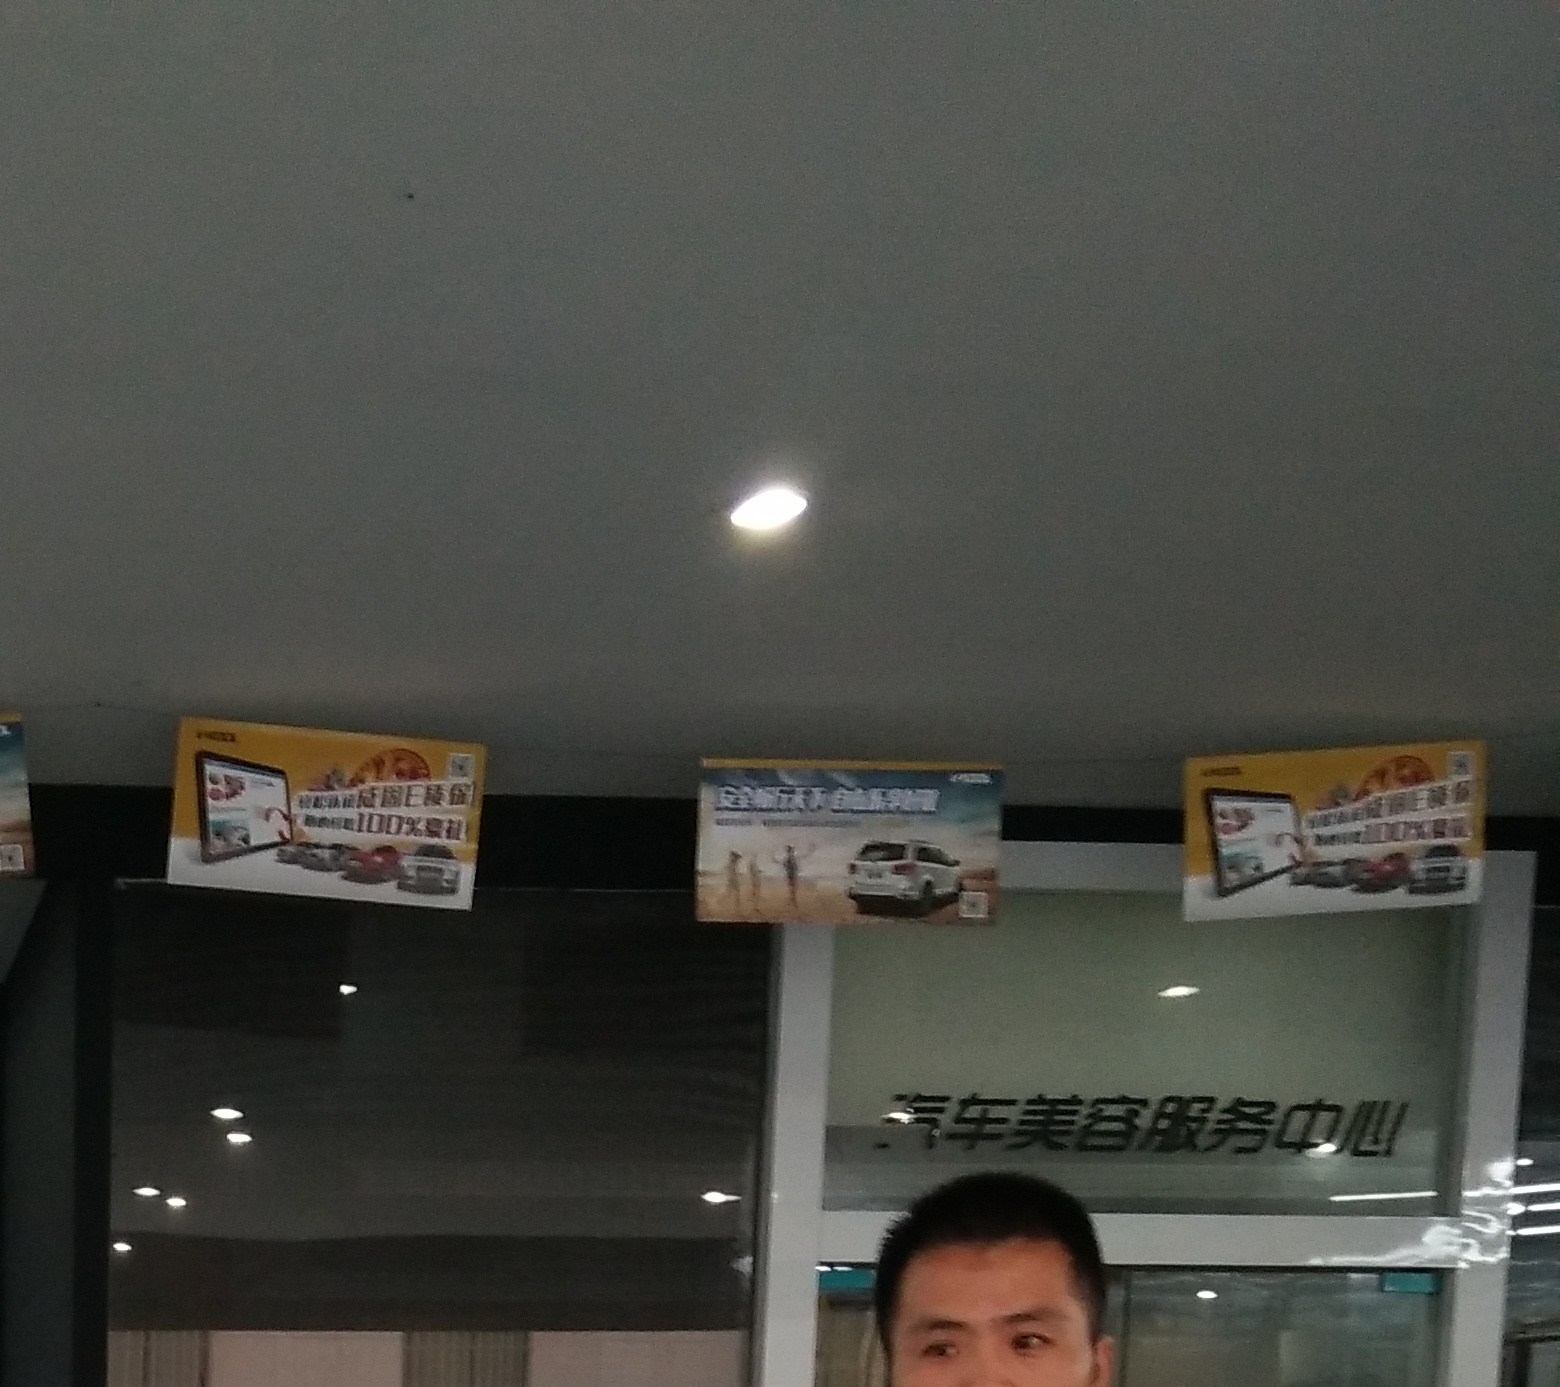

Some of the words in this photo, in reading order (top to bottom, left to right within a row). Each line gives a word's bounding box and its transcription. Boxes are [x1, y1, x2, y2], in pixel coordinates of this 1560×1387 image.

[874, 1093, 1409, 1157] 汽车美容服务中心
